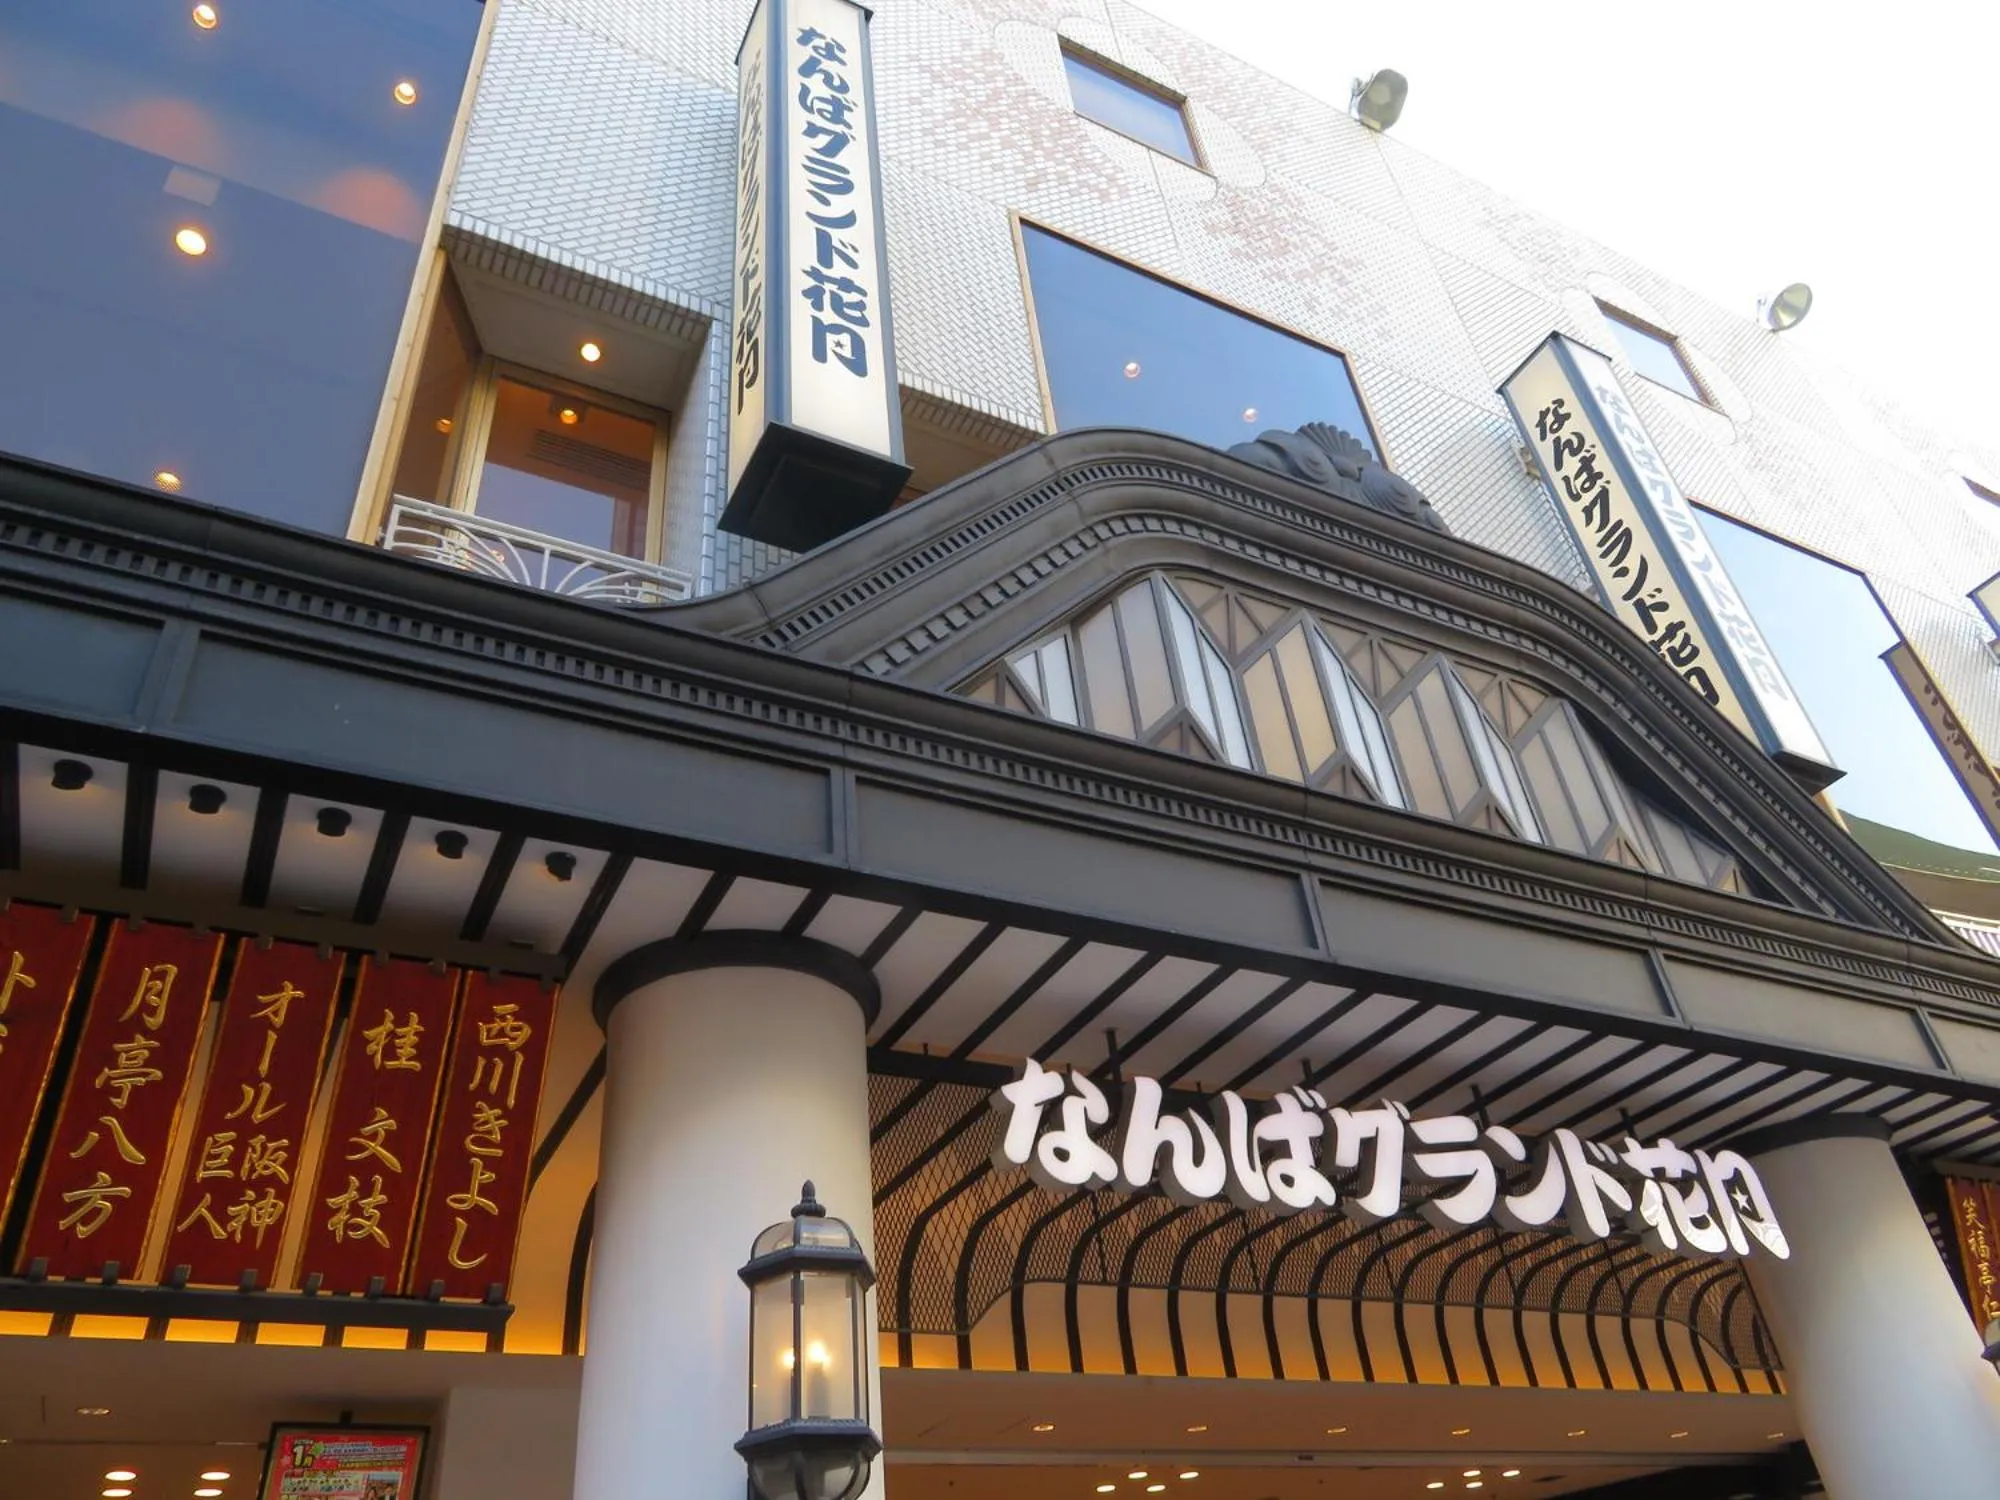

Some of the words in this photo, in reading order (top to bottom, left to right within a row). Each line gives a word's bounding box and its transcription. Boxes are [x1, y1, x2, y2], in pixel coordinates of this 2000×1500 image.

[795, 26, 870, 378] なんばグランド花月
[59, 964, 178, 1239] 月亭八方
[446, 1004, 533, 1270] 西川きよし
[1000, 1057, 1791, 1260] なんばグランド花月
